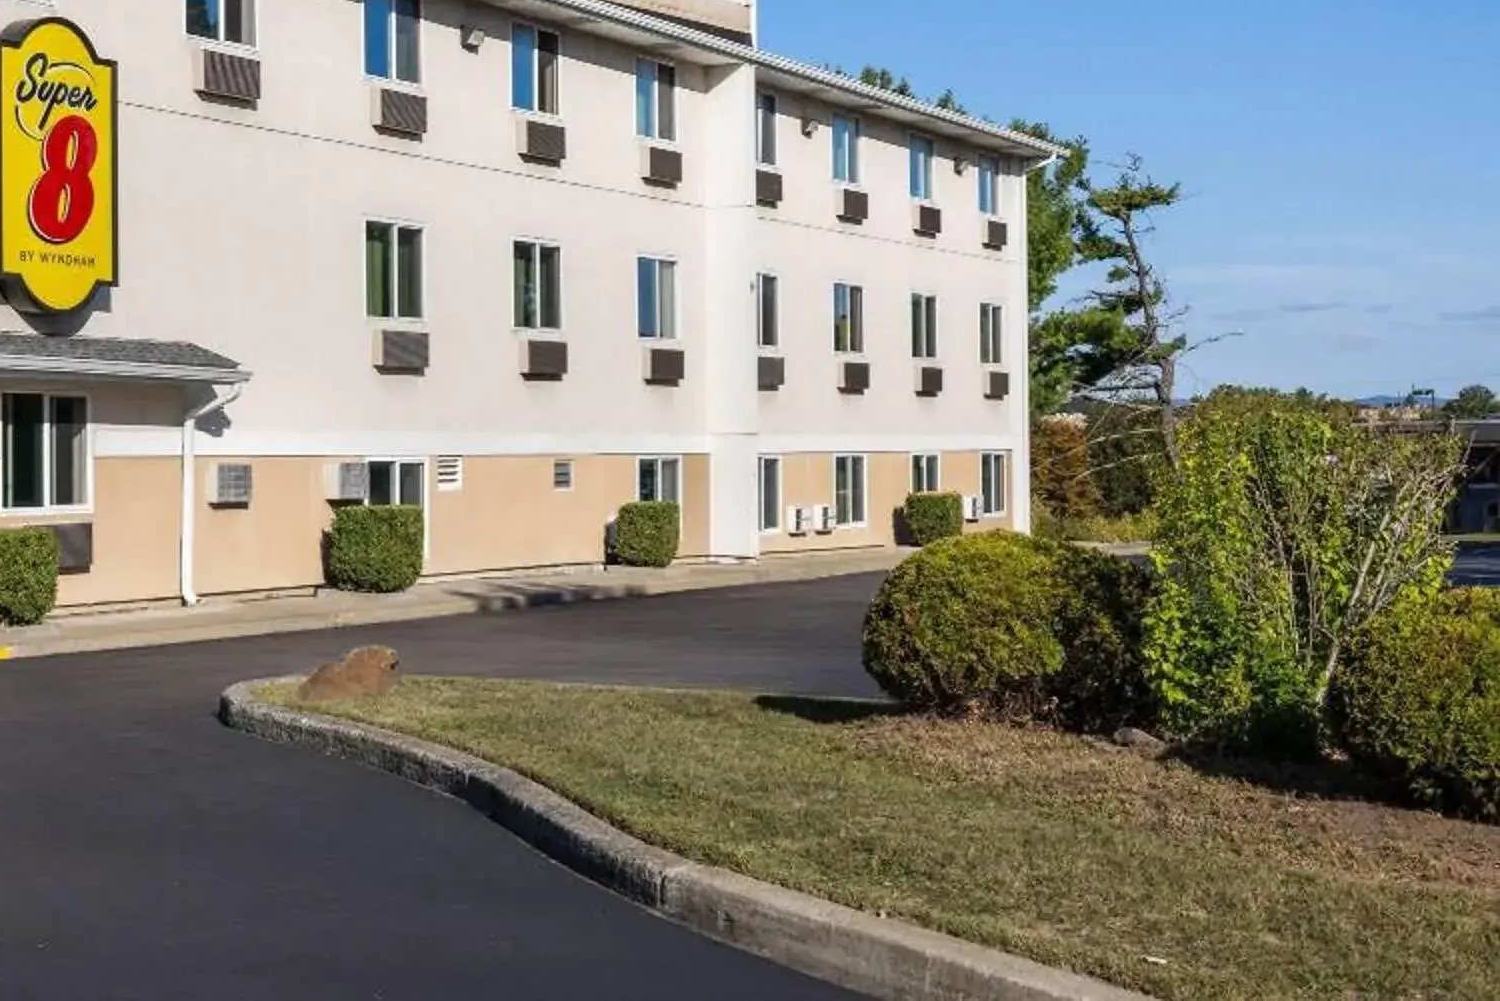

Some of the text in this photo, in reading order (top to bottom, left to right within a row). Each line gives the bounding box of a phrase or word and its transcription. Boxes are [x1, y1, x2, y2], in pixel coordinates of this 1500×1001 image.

[16, 52, 98, 131] Super
[27, 114, 98, 244] 8
[19, 251, 96, 267] BY WYNDHAM
